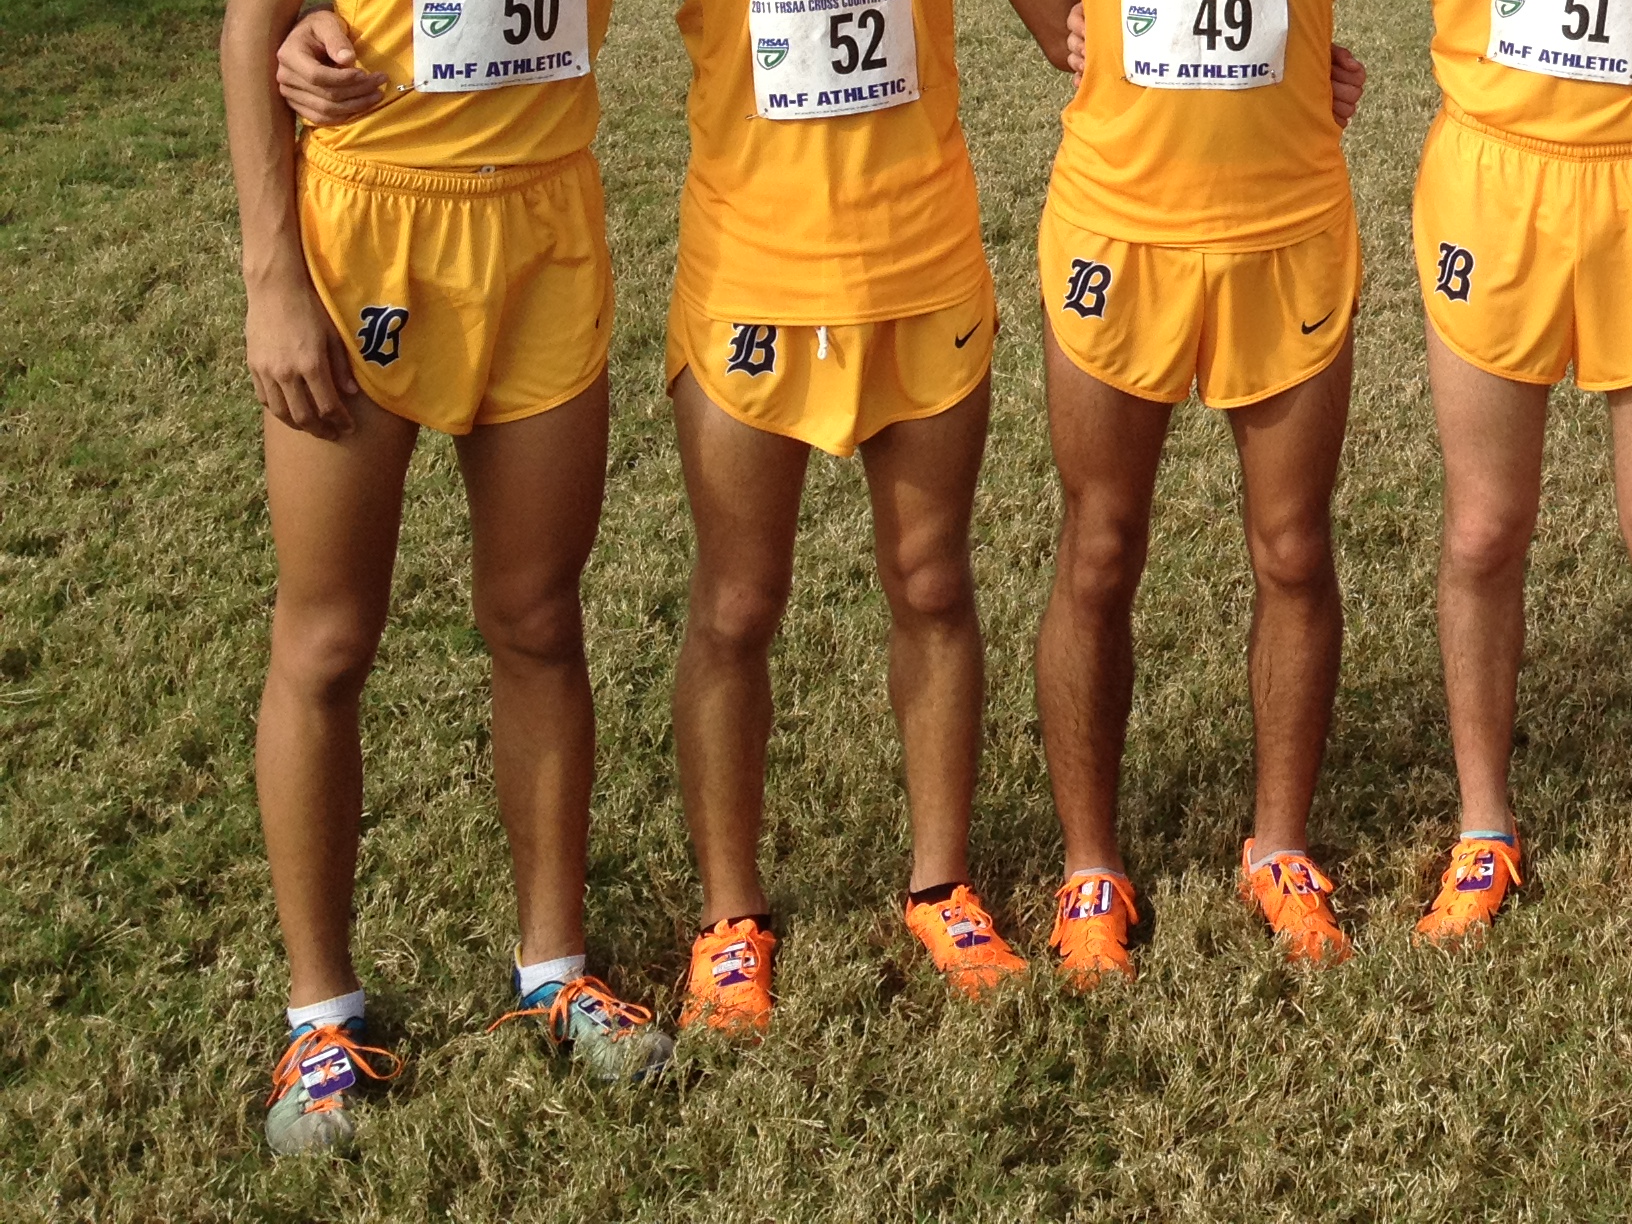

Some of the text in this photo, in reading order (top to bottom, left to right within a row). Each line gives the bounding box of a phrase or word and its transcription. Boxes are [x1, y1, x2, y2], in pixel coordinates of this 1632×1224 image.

[424, 3, 462, 11] FHSAA
[752, 1, 771, 14] 2011
[775, 1, 806, 13] FHSAA
[1129, 6, 1157, 15] FHSAA
[758, 38, 789, 47] FHSAA
[830, 9, 887, 75] 52
[1499, 40, 1532, 59] M-F
[1538, 49, 1628, 73] ATHLETIC
[432, 51, 572, 79] M-F ATHLETIC
[1135, 61, 1269, 78] M-F ATHLETIC
[769, 93, 808, 108] M-F
[817, 78, 906, 106] ATHLETIC
[1434, 241, 1475, 305] B
[1061, 257, 1112, 321] B
[355, 303, 410, 368] B
[725, 323, 778, 378] B
